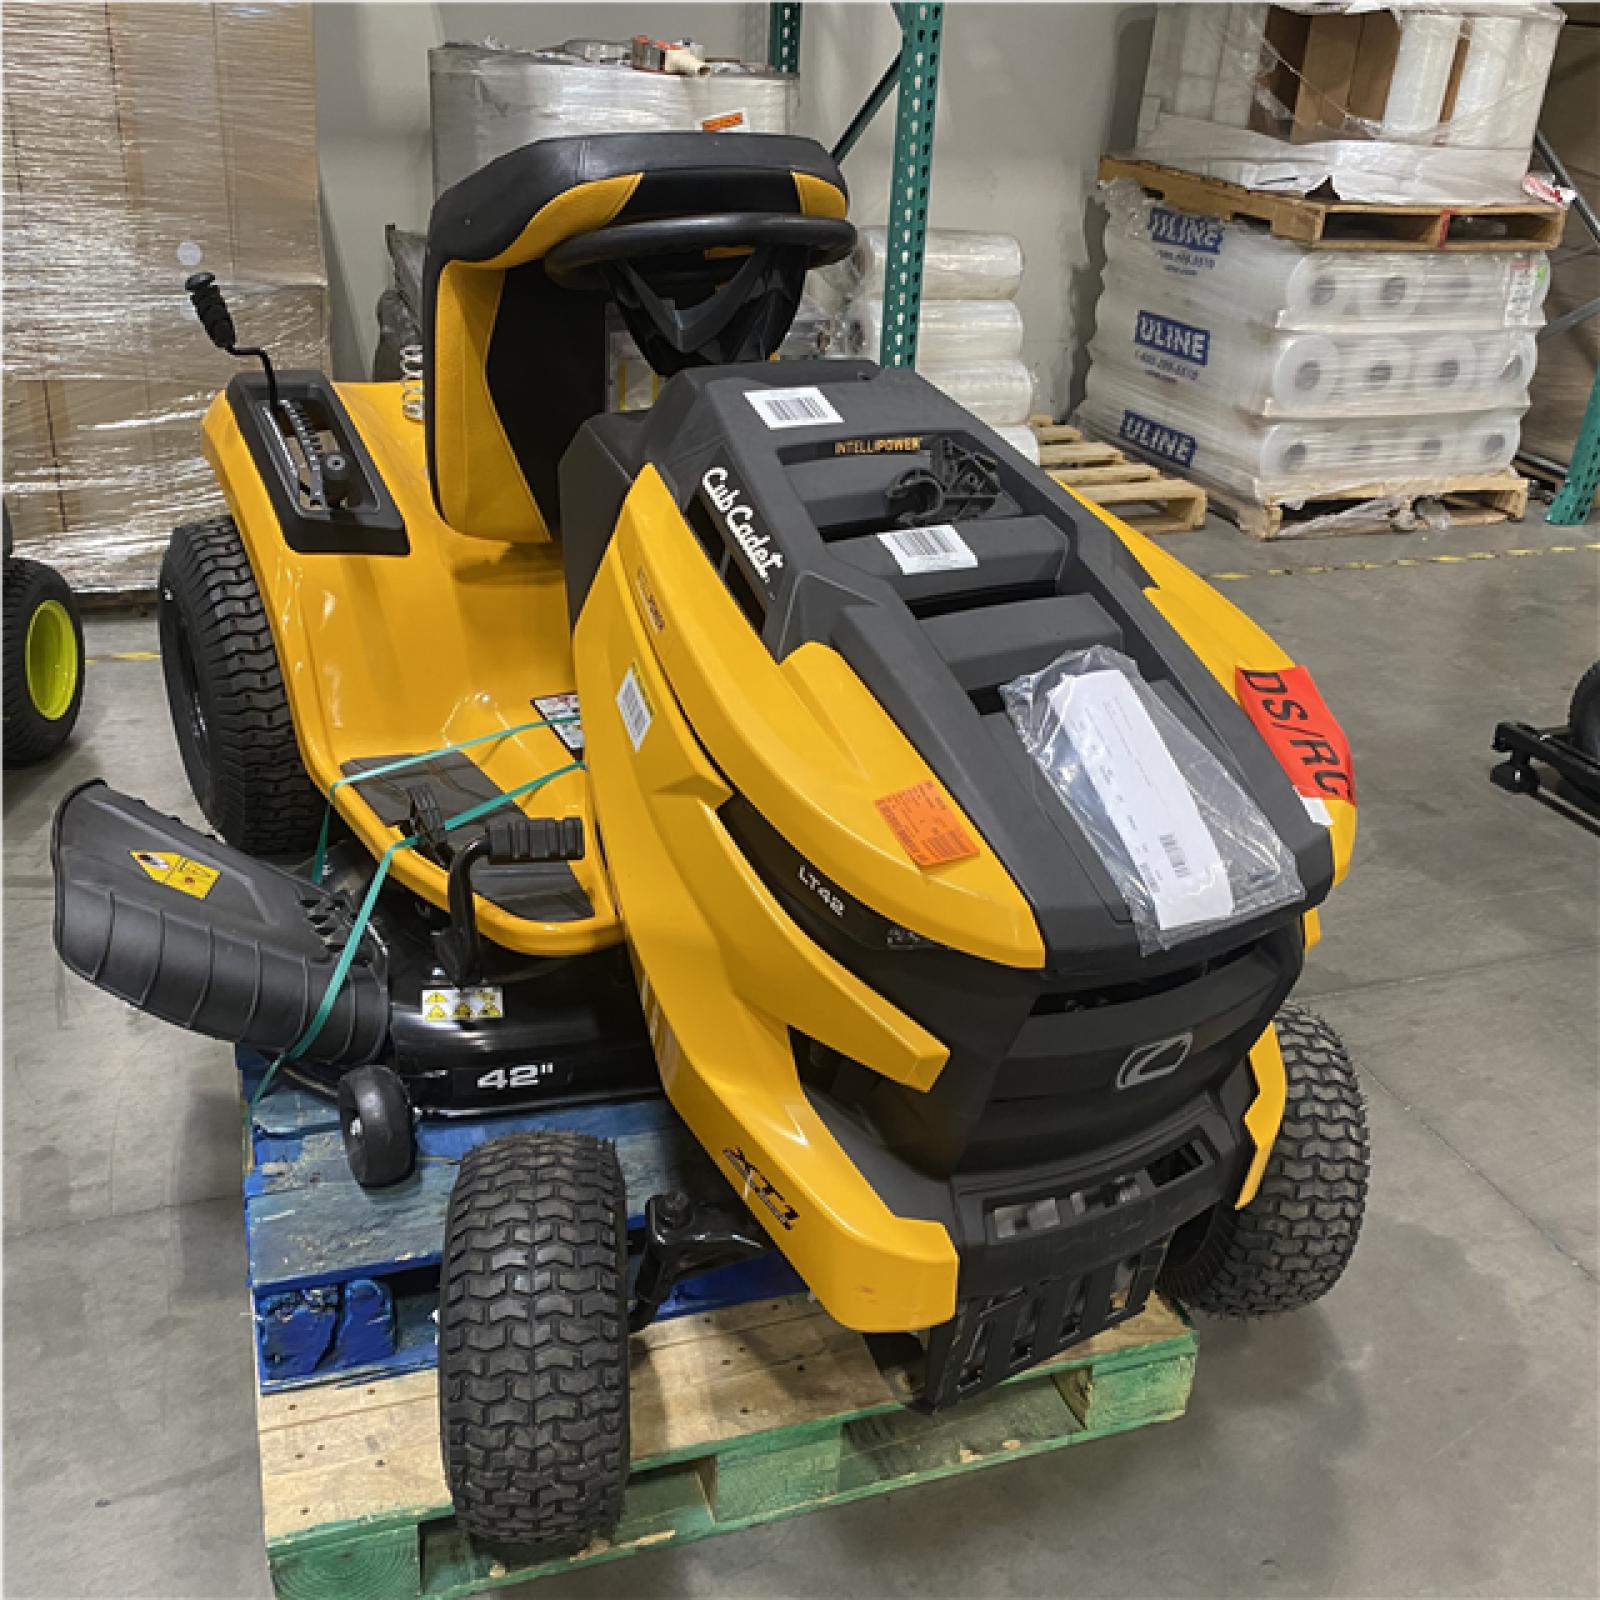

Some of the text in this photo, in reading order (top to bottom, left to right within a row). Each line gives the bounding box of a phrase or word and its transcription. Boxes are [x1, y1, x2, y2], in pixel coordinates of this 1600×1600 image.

[1151, 214, 1219, 246] ULINE
[1139, 316, 1206, 360] ULINE
[1124, 416, 1191, 461] ULINE
[702, 467, 784, 584] Cub Cadet
[476, 1062, 554, 1090] 42"
